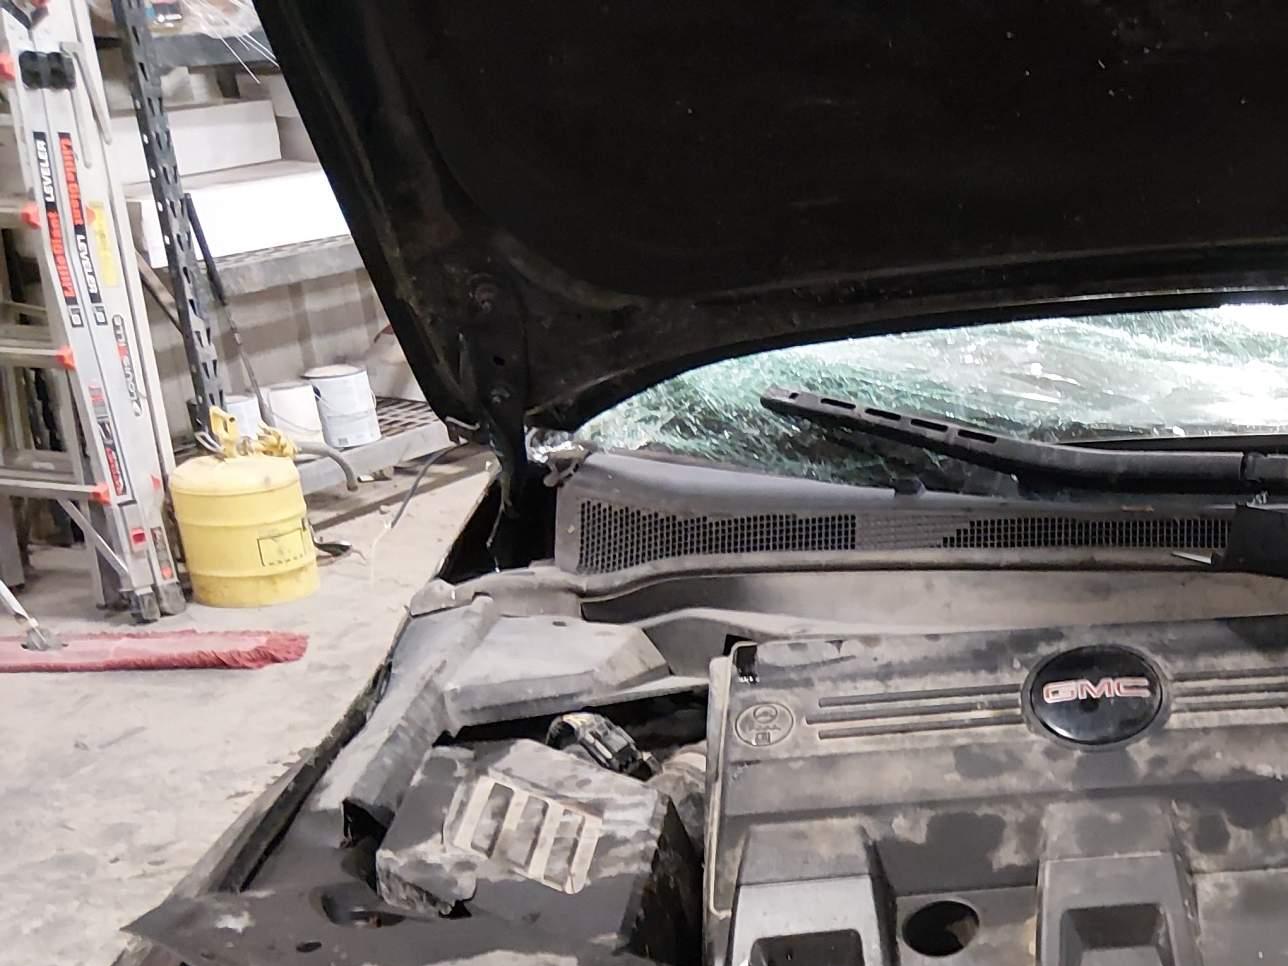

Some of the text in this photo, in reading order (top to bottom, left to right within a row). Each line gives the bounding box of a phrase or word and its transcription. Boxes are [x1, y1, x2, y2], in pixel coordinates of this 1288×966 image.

[36, 139, 55, 203] LEVELER
[76, 234, 98, 293] LEVELER
[1043, 677, 1151, 704] GMC
